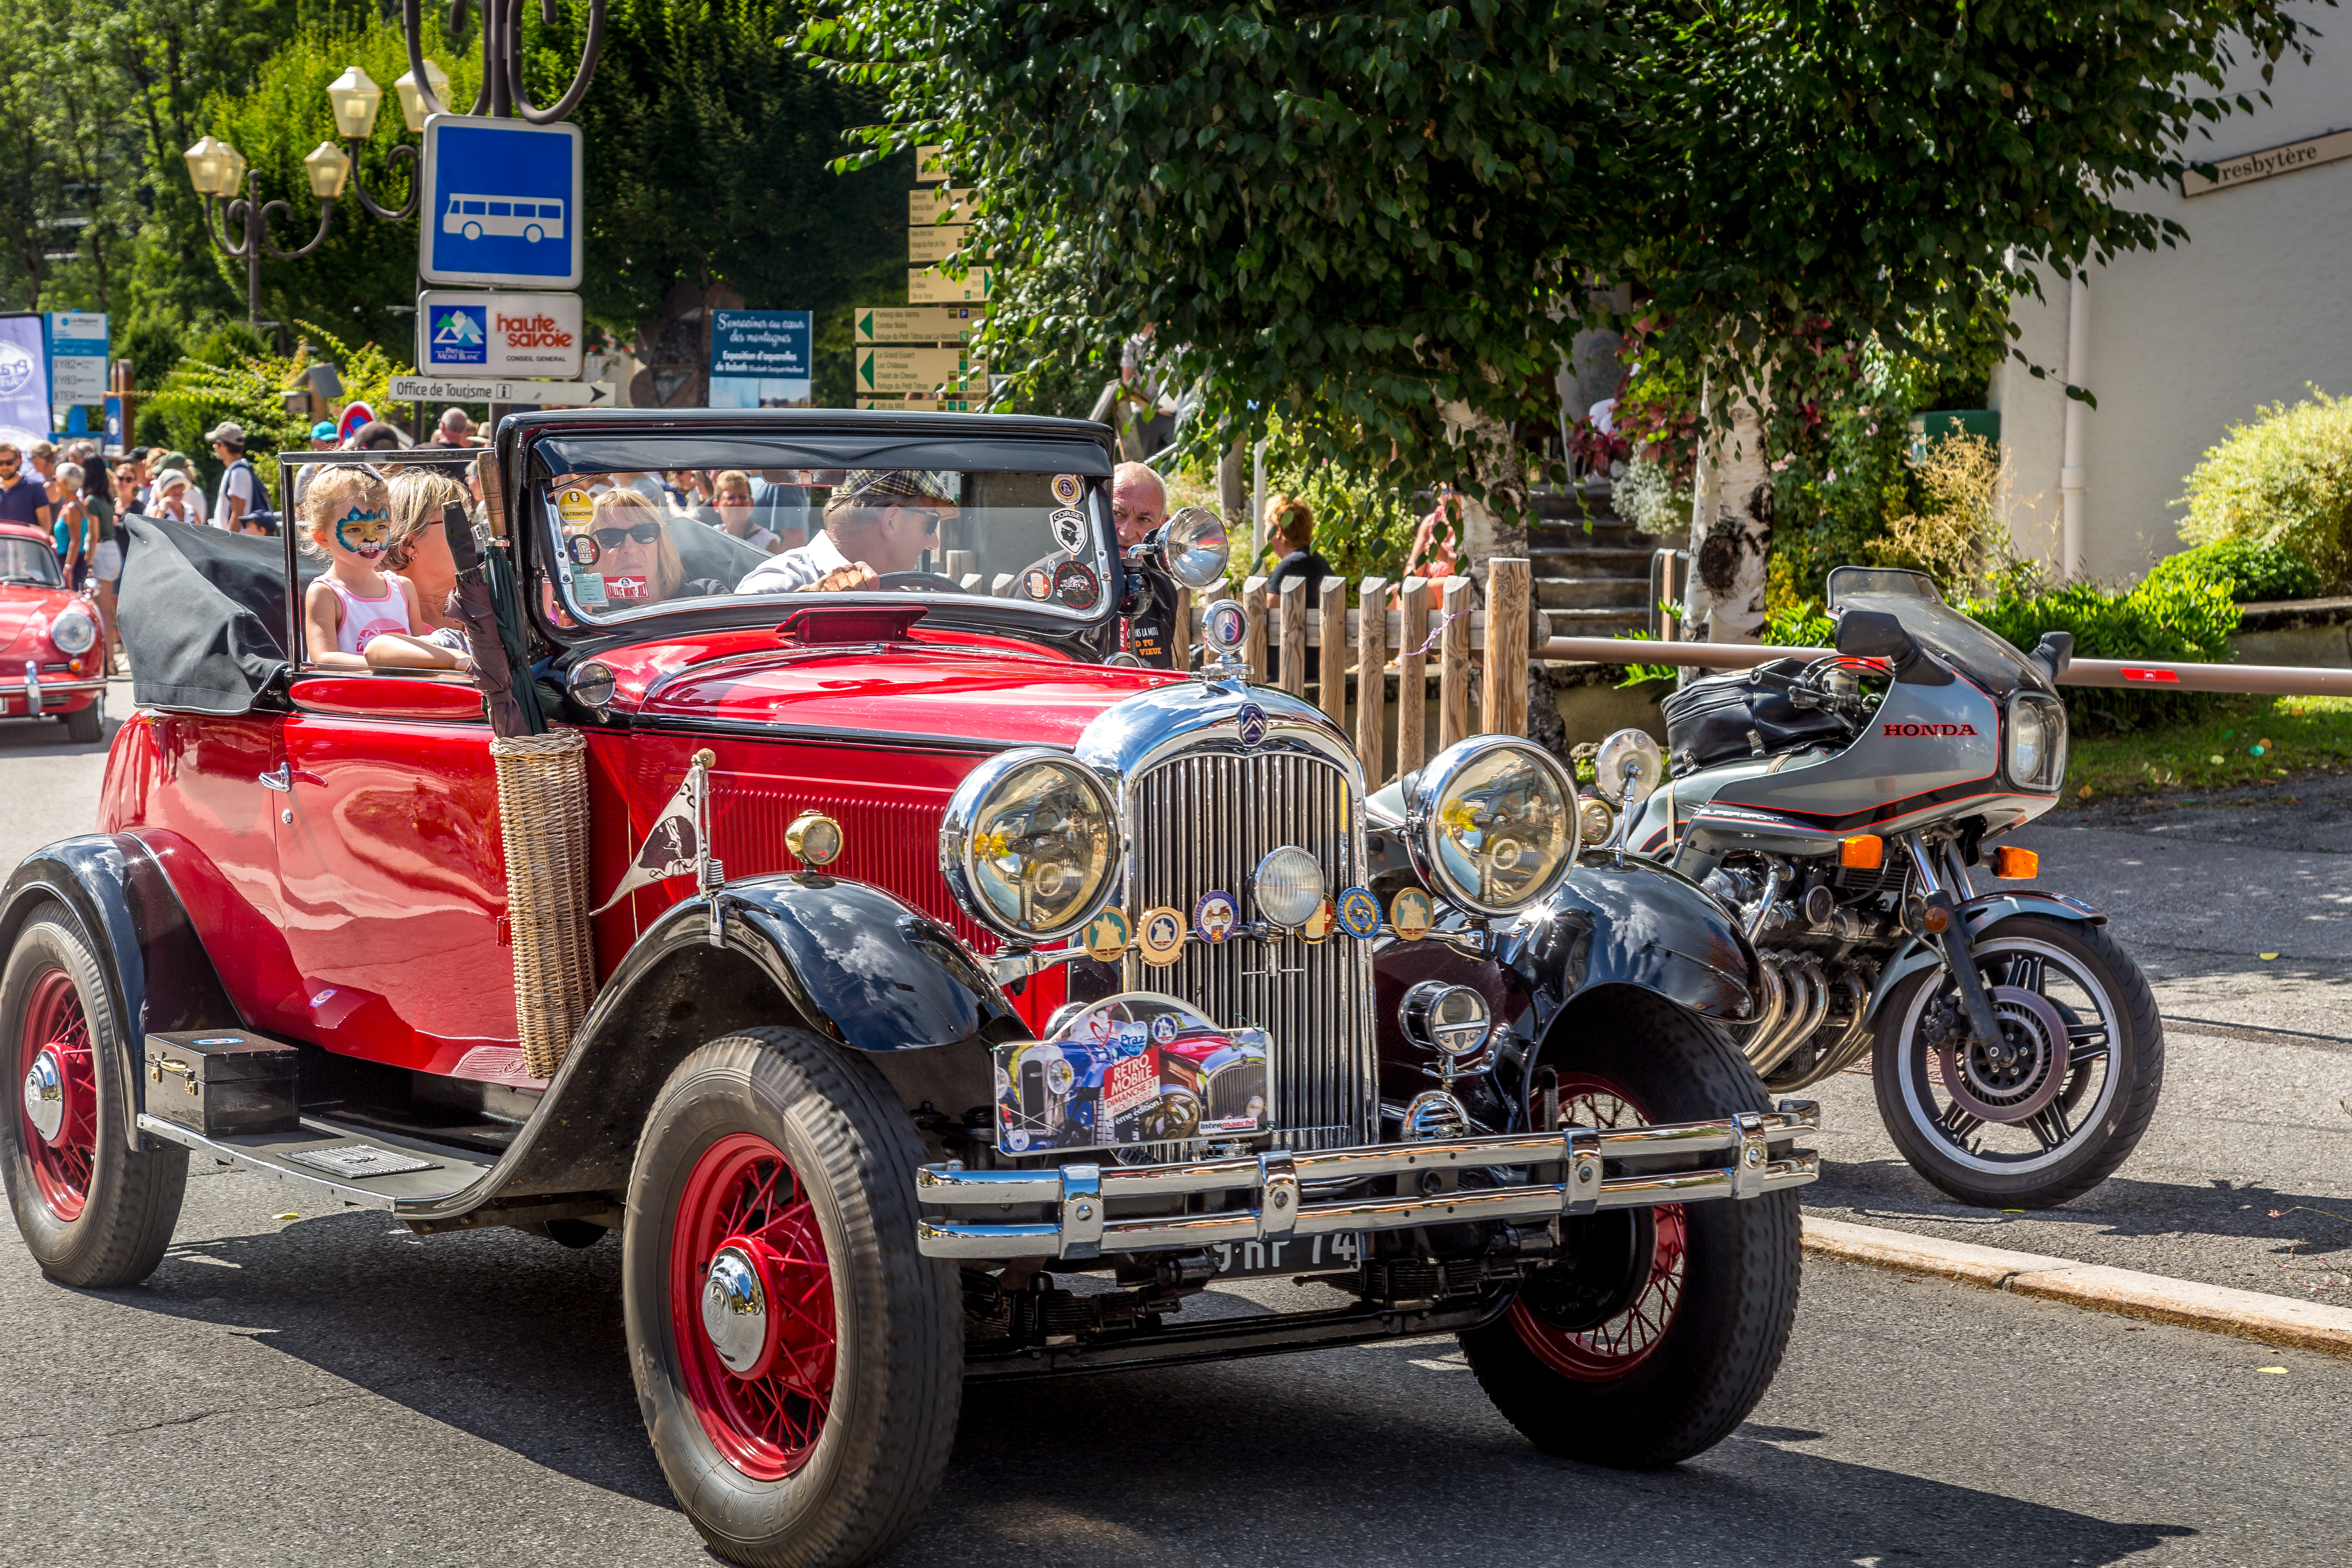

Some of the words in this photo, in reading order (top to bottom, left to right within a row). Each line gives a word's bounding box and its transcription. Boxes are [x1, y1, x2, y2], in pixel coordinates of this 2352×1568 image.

[2217, 146, 2317, 180] resbytère
[508, 332, 572, 347] savoie
[397, 381, 427, 395] Office
[430, 383, 442, 396] de
[445, 383, 492, 398] Tourisme
[1054, 511, 1082, 520] CORSE
[606, 583, 623, 597] RALLYE
[1142, 628, 1147, 637] LA
[1139, 647, 1162, 655] VIEUX
[1883, 724, 1978, 736] HONDA
[1121, 1034, 1145, 1045] Praz
[1111, 1065, 1152, 1096] MOBILE
[1107, 1082, 1148, 1109] DIMANCHE
[1148, 1079, 1156, 1089] 21
[1134, 1090, 1152, 1104] 2022
